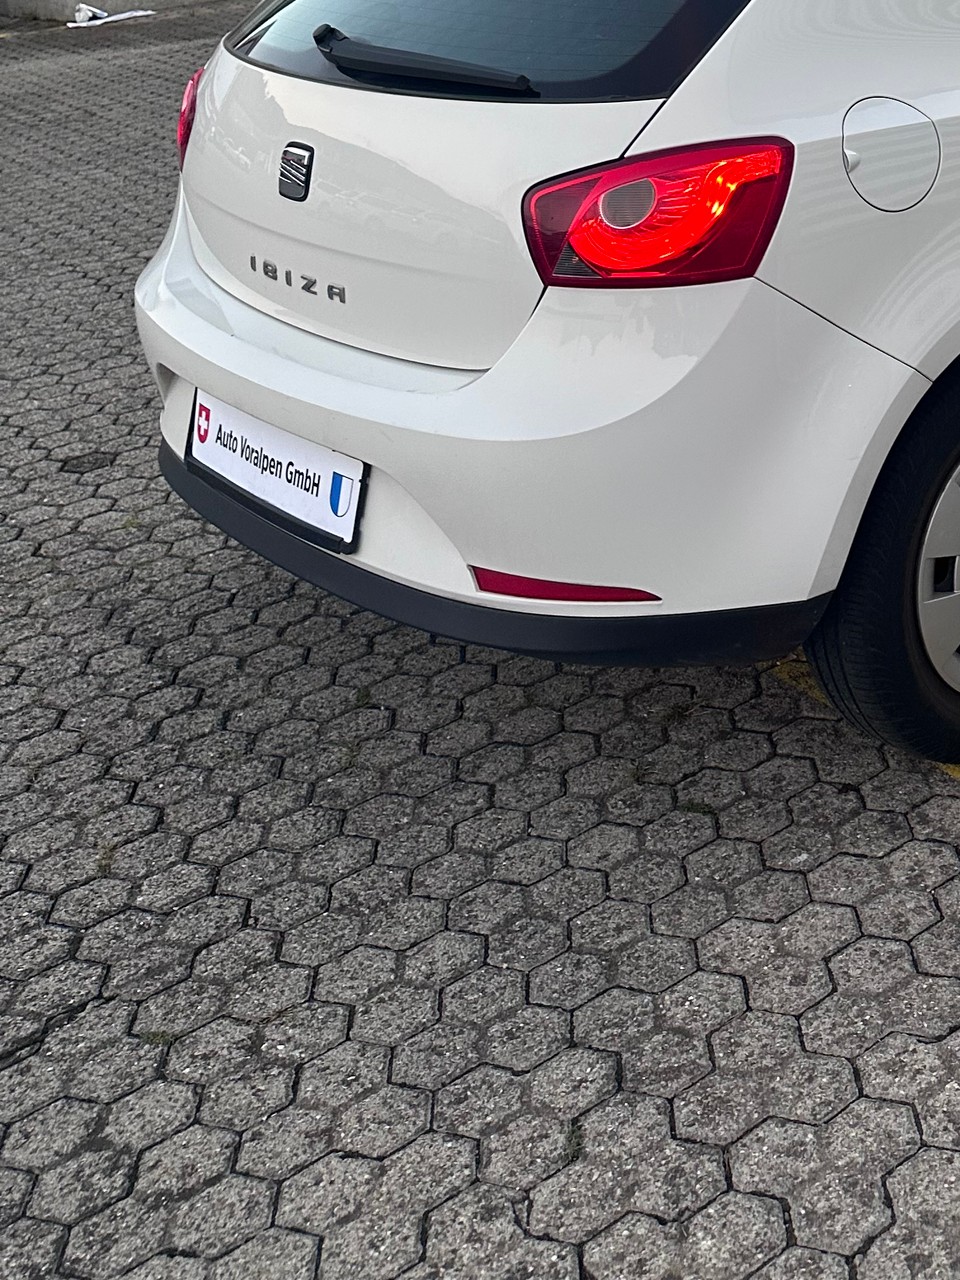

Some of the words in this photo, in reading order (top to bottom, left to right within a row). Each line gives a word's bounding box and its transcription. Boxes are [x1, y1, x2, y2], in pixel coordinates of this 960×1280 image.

[250, 254, 346, 304] IBIZA
[215, 423, 238, 453] Auto
[240, 435, 283, 479] Voralpen
[285, 461, 321, 497] GmbH
